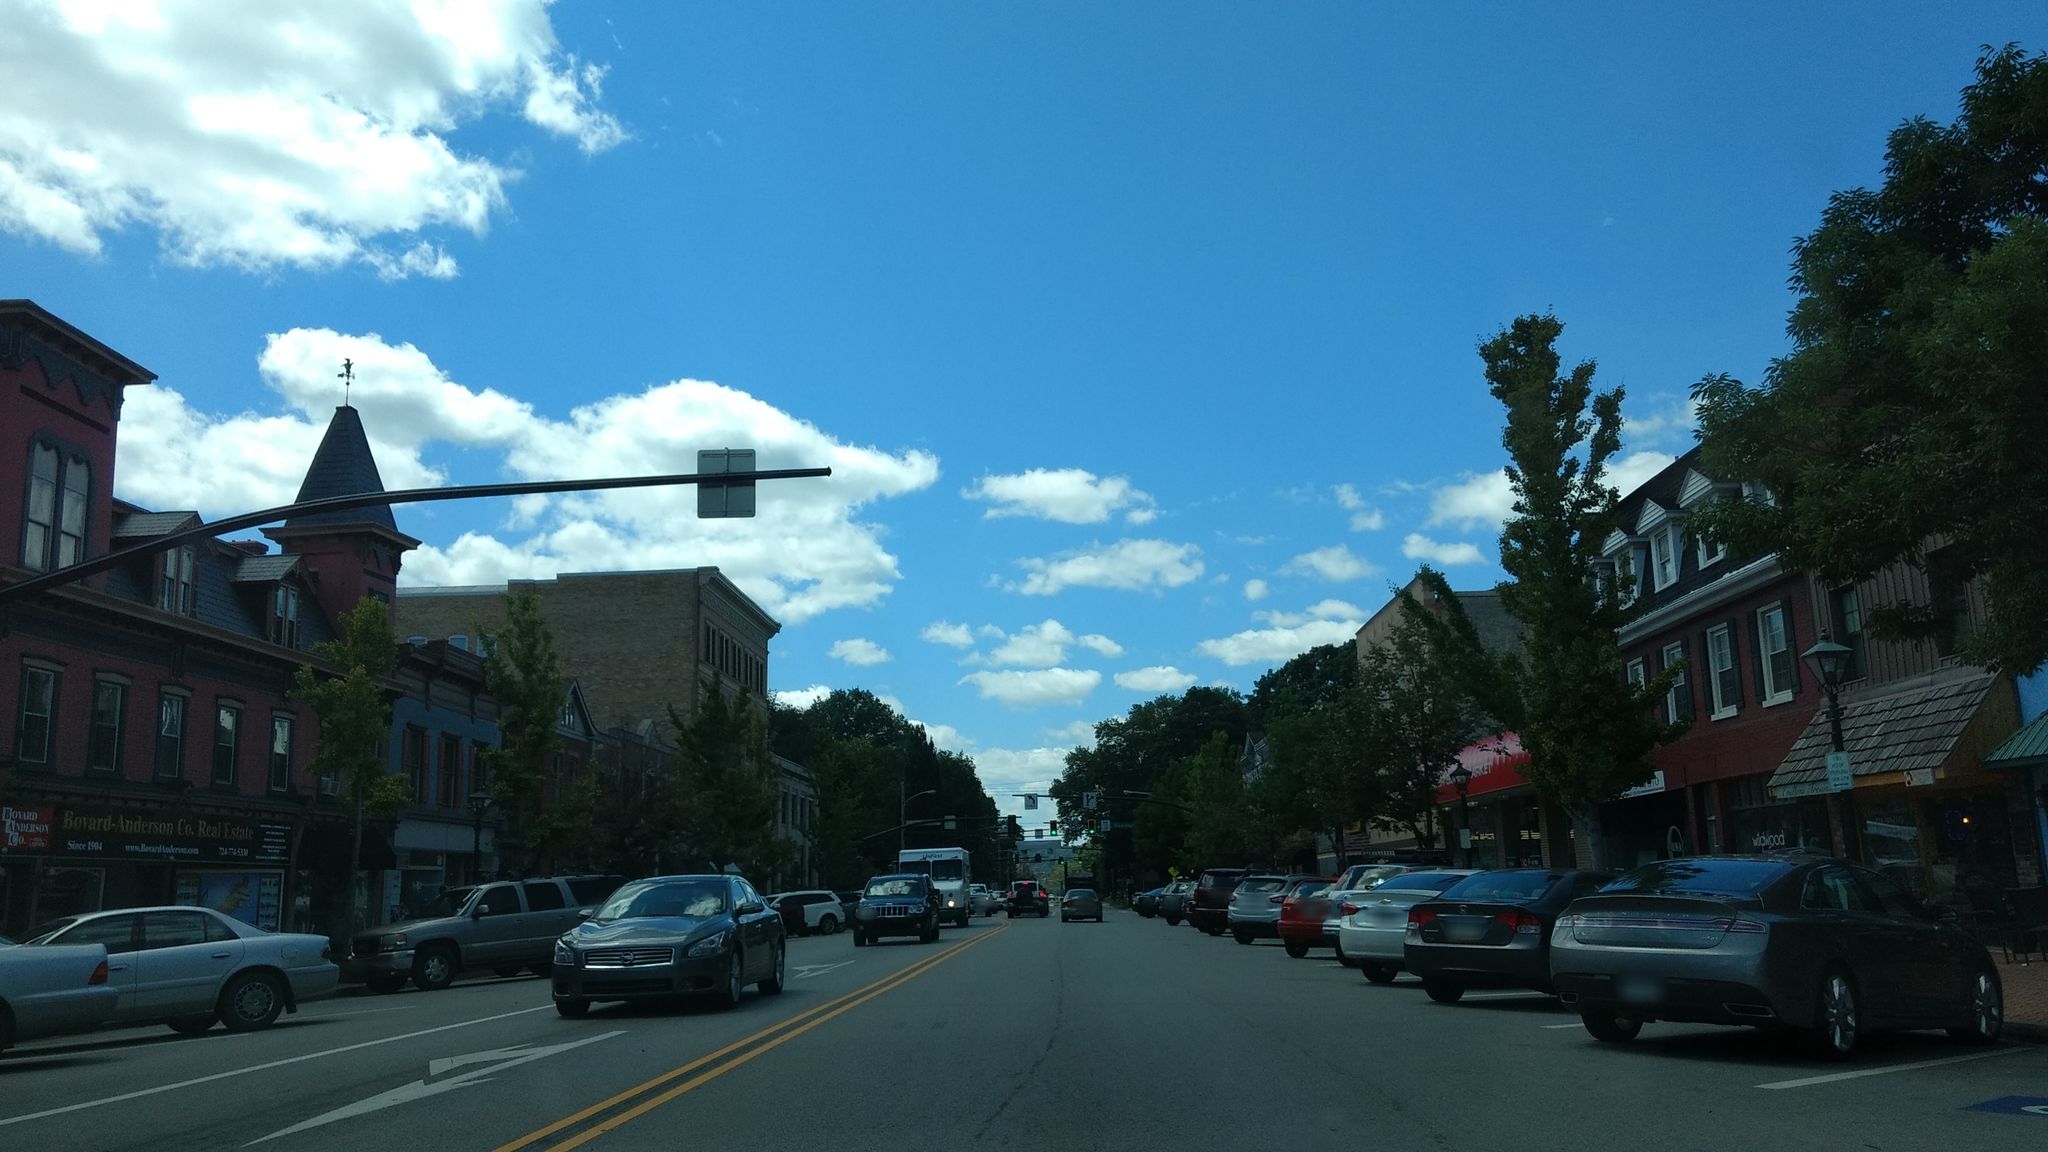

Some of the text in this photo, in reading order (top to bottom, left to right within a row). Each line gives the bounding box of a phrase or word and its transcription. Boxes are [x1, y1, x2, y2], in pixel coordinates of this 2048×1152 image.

[2, 807, 38, 821] BOVARD
[5, 820, 49, 834] ANDERSON
[63, 809, 255, 840] Bovard-Anderson Co. Real Estate
[68, 840, 102, 851] Since 1904
